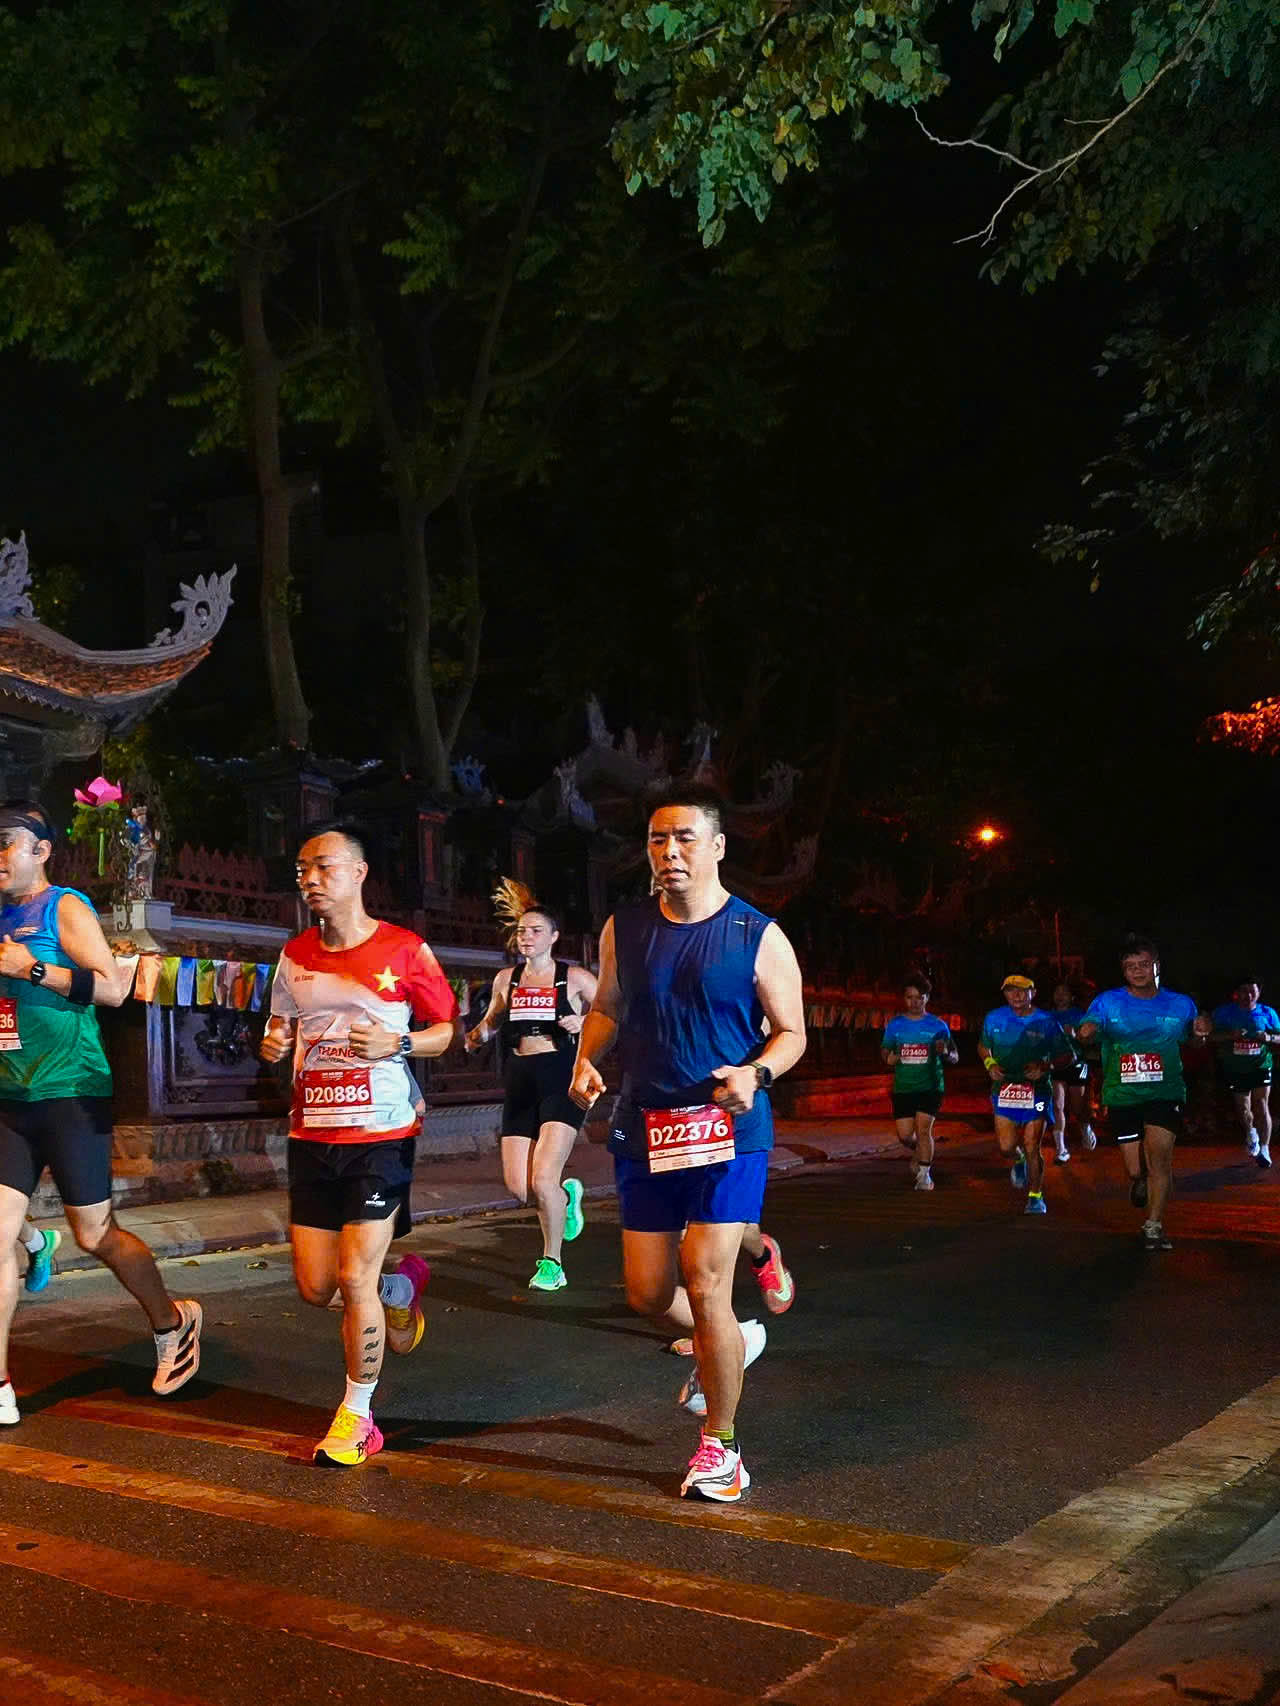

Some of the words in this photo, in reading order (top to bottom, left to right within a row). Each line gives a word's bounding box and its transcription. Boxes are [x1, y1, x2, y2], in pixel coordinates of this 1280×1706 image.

[512, 996, 554, 1007] D21893
[1121, 1060, 1161, 1071] D2616
[304, 1084, 370, 1104] D20886
[649, 1119, 729, 1147] D22376
